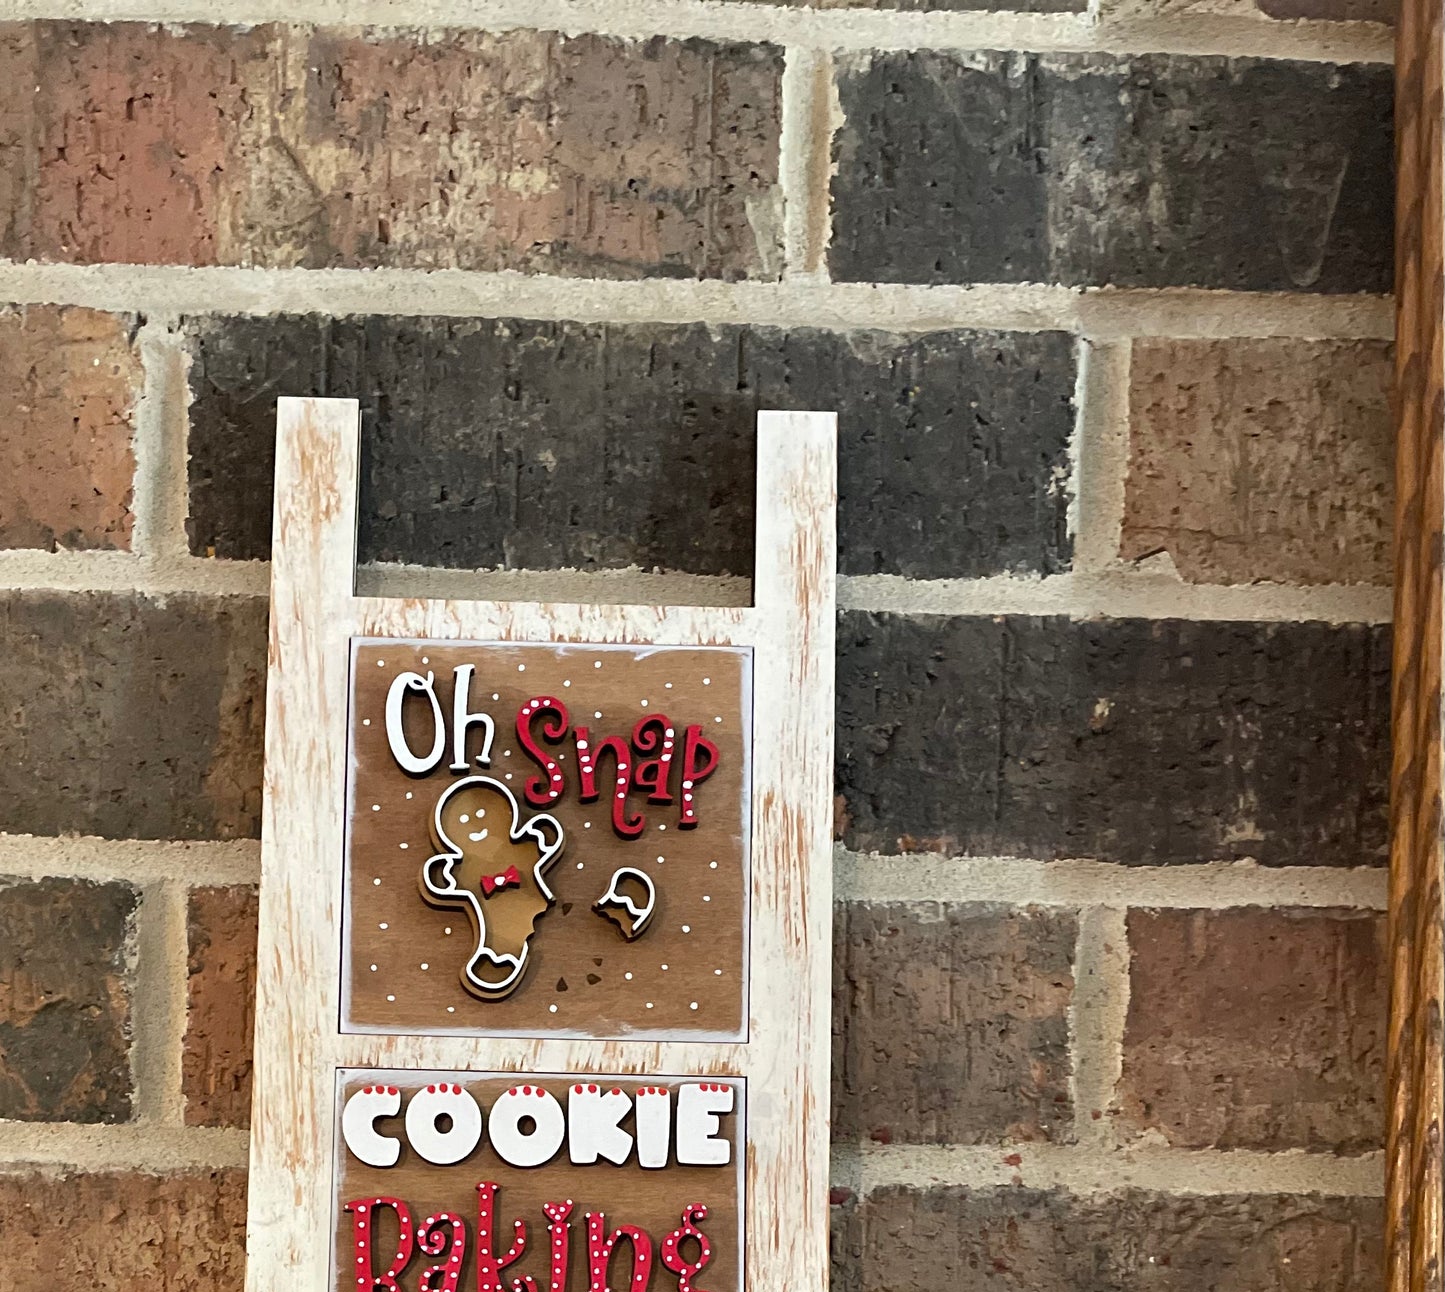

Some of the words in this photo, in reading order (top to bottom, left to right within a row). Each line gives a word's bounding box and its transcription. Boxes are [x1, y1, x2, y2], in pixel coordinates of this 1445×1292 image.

[385, 664, 495, 774] Oh
[516, 696, 720, 838] Snap
[342, 1083, 734, 1167] COOKIE
